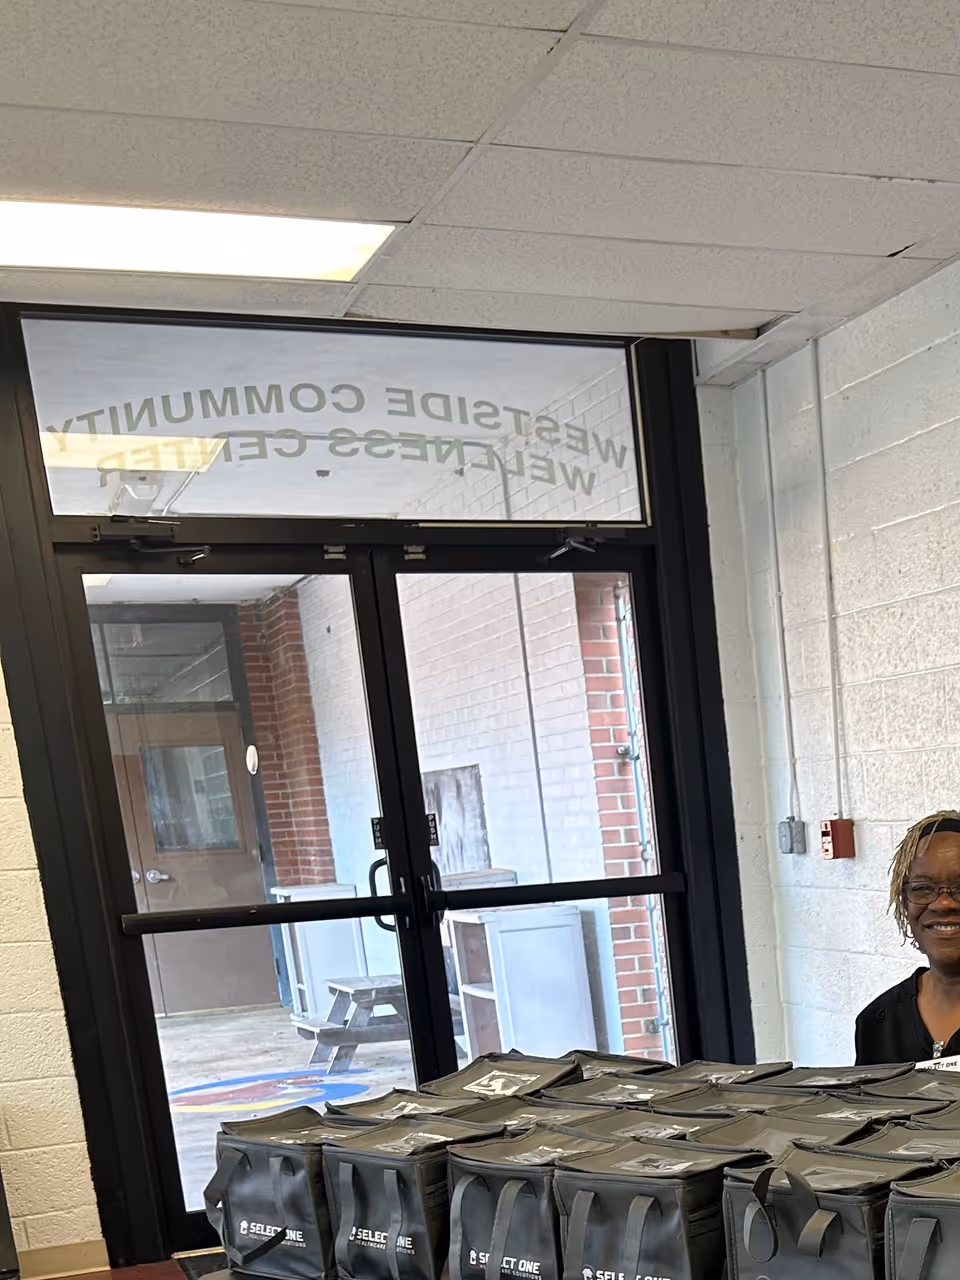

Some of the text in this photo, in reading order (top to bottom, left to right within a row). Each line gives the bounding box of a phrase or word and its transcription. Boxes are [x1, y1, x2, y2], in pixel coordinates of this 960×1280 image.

[373, 818, 382, 843] PUSH
[428, 814, 437, 840] PUSH
[356, 1227, 413, 1248] SELEC NE
[518, 1259, 541, 1274] ONE
